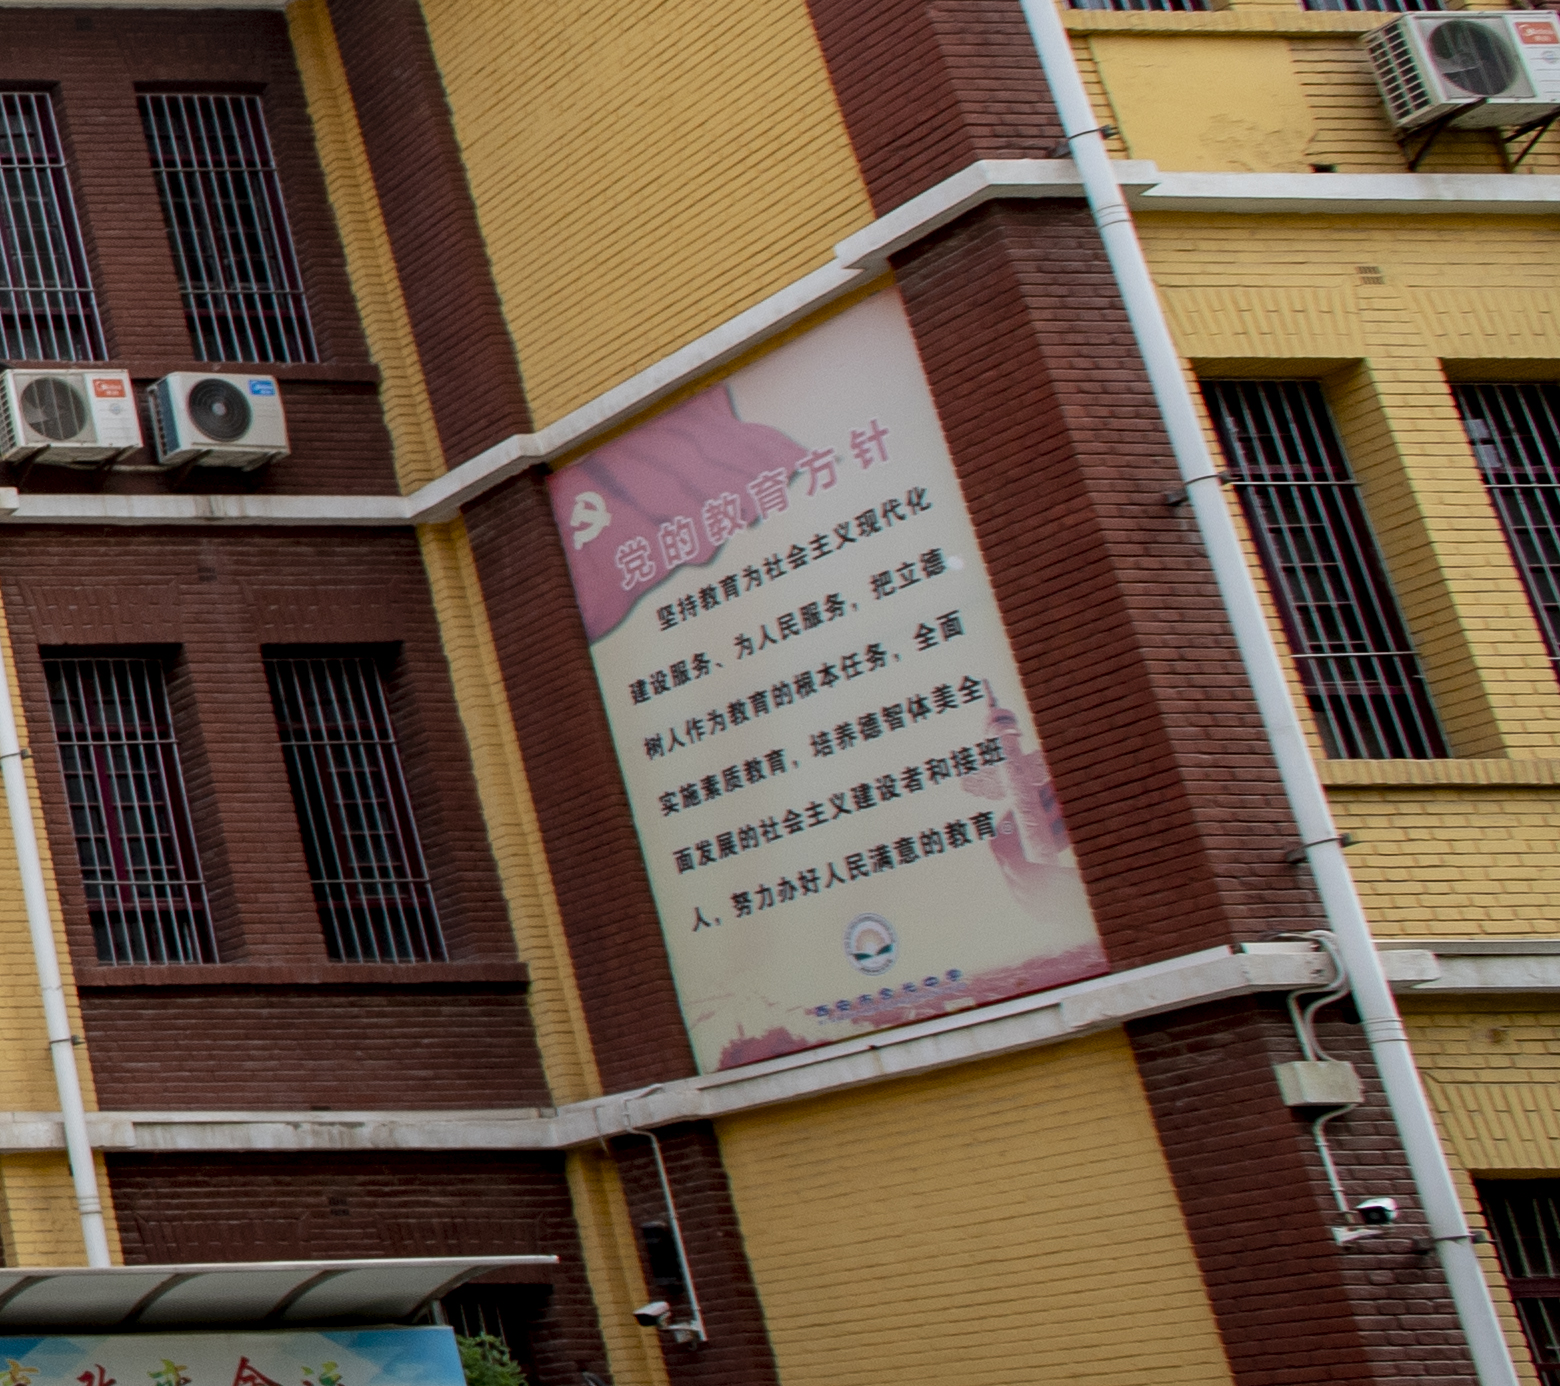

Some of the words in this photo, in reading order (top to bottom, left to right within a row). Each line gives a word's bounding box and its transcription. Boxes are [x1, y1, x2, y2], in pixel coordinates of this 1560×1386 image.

[615, 418, 890, 591] 党的教育方针
[656, 486, 934, 632] 坚持教育为社会主义现代化
[673, 736, 1007, 874] 面发展的社会主义建设者和接班
